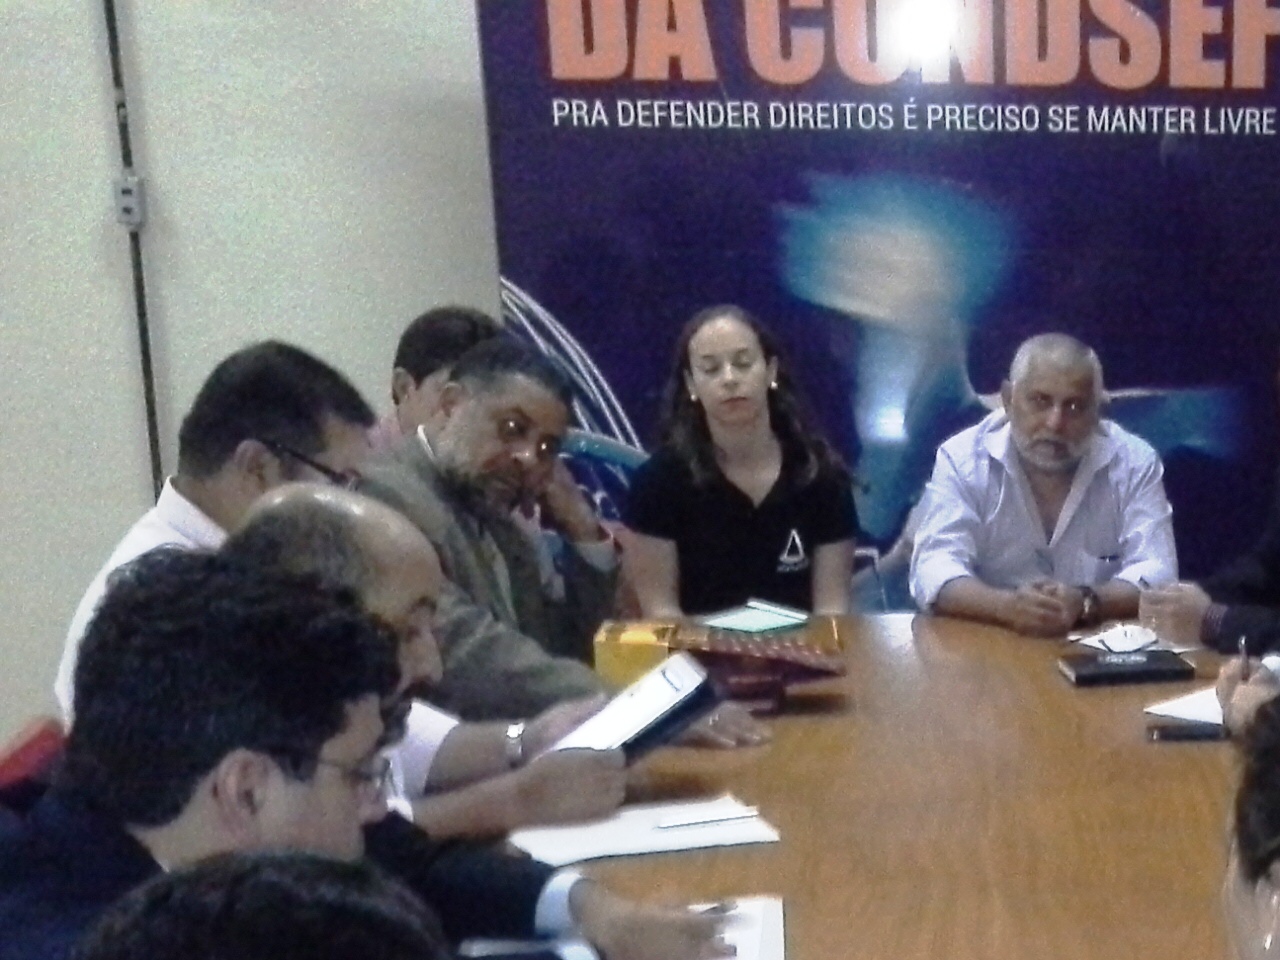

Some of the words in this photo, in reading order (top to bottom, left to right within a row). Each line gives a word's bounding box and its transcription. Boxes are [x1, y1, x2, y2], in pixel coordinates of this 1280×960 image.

[547, 0, 718, 80] DA
[552, 100, 608, 127] PRA
[617, 100, 761, 128] DEFENDER
[769, 102, 894, 129] DIREITOS
[903, 97, 918, 129] É
[927, 104, 1040, 132] PRECISO
[1048, 105, 1079, 132] SE
[1087, 106, 1196, 133] MANTER
[1204, 107, 1276, 135] LIVRE
